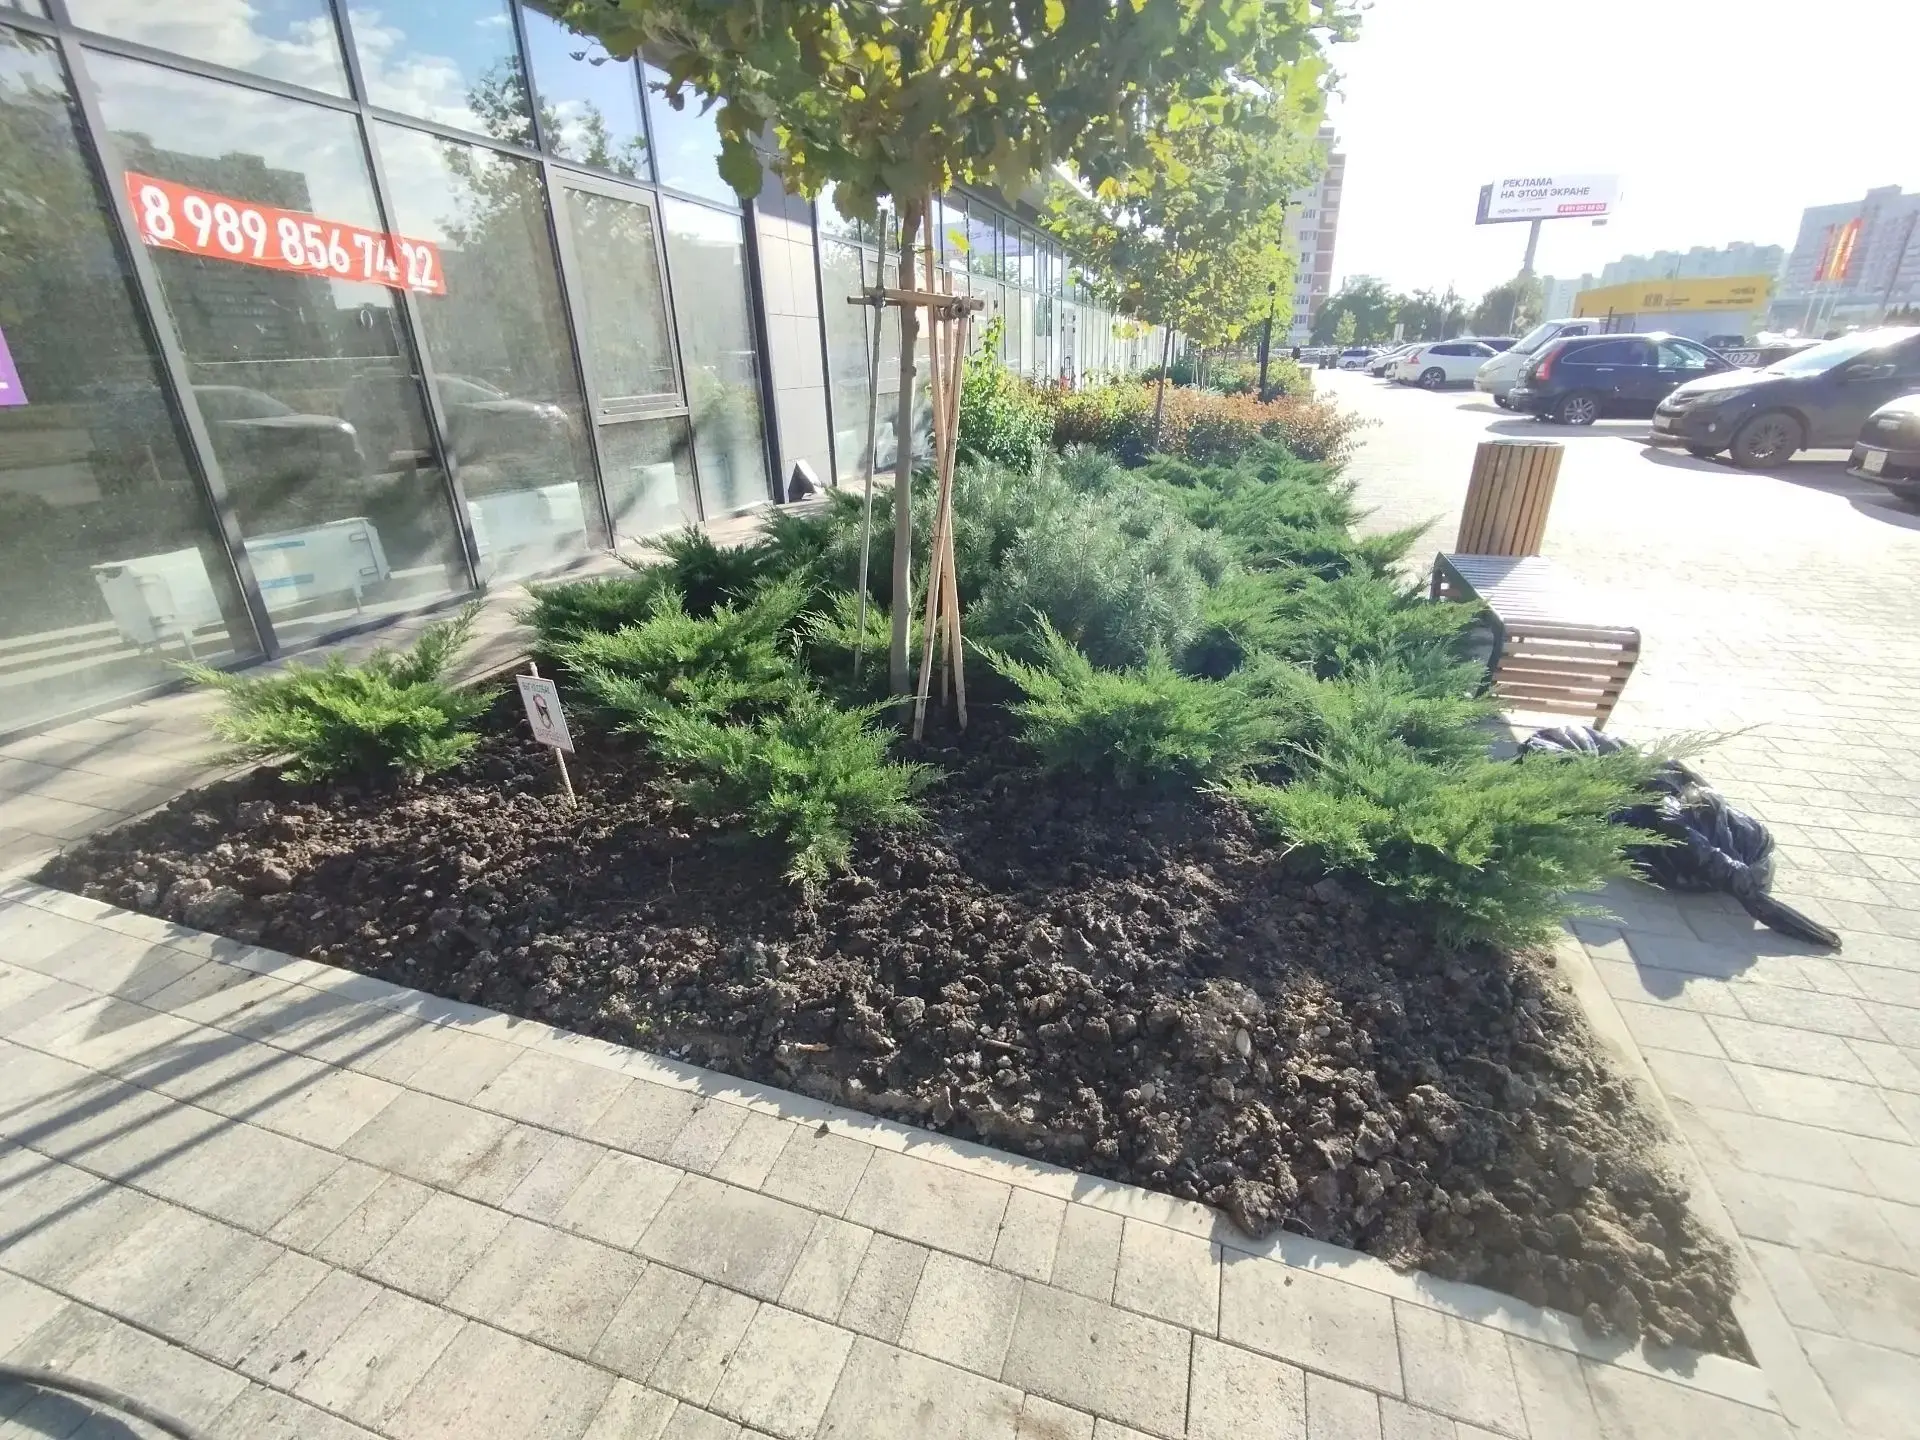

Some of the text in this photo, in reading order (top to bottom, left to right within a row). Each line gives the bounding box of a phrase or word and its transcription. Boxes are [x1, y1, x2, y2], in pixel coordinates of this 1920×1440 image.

[1502, 178, 1552, 188] РЕКЛАМА
[1500, 187, 1590, 199] НА ЭТОМ ЭКРАНЕ
[139, 184, 175, 240] 8
[183, 195, 267, 259] 989
[277, 217, 350, 273] 856
